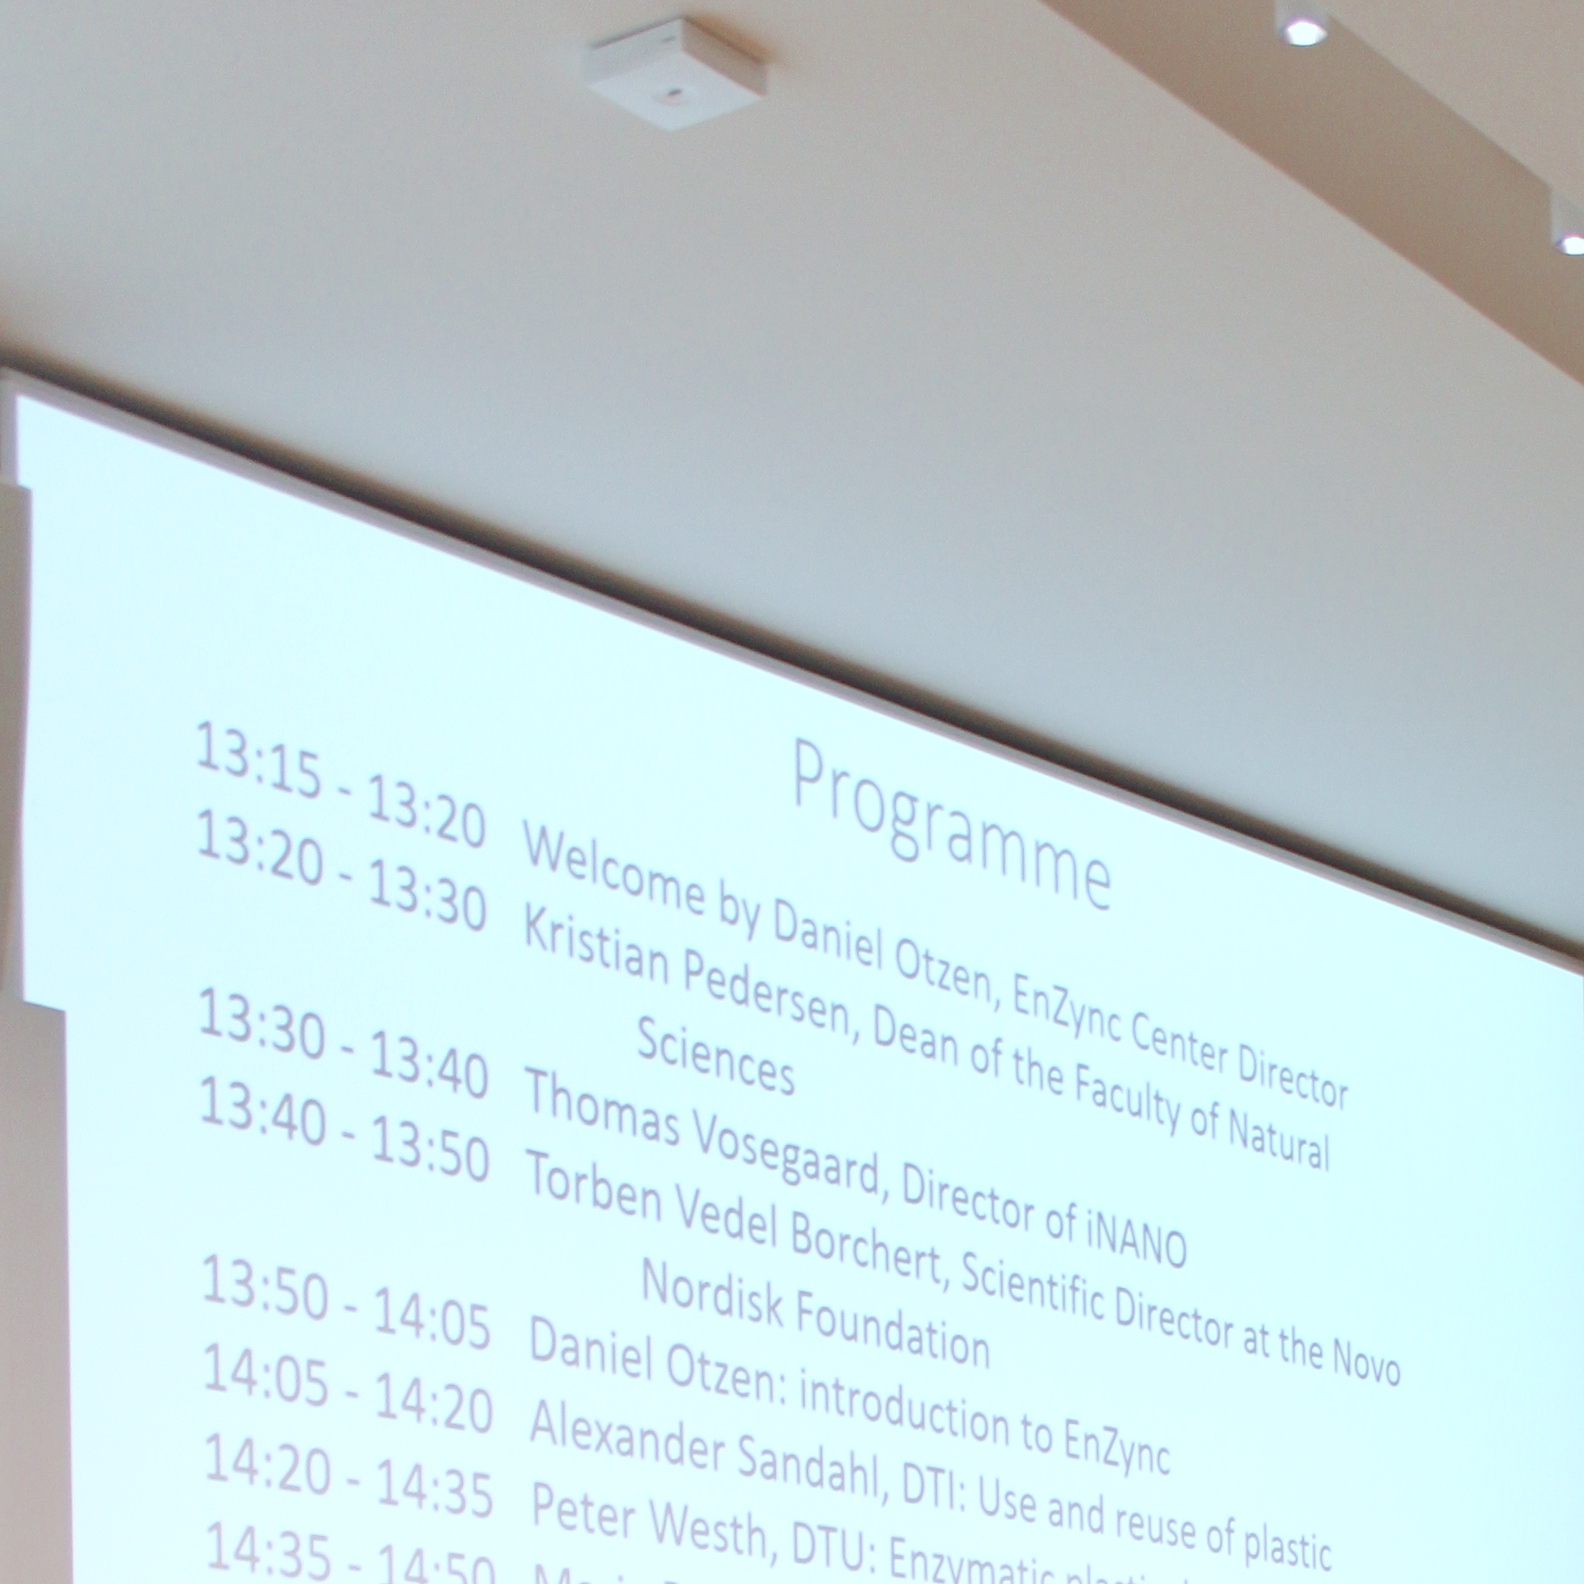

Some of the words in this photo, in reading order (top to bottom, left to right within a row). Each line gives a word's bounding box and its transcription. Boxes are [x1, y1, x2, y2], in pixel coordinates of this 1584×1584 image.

[197, 720, 322, 800] 13:15
[369, 774, 486, 849] 13:20
[523, 820, 705, 916] Welcome
[720, 879, 761, 942] by
[774, 898, 882, 969] Daniel
[895, 938, 1001, 1012] Otzen,
[1014, 973, 1121, 1042] EnZync
[1132, 1011, 1228, 1072] Center
[1239, 1043, 1349, 1109] Director
[795, 737, 1111, 911] Programme
[198, 808, 324, 886] 13:20
[370, 858, 487, 932] 13:30
[526, 902, 669, 984] Kristian
[685, 948, 860, 1045] Pedersen,
[874, 1003, 958, 1065] Dean
[970, 1037, 1003, 1077] of
[1012, 1047, 1064, 1096] the
[1076, 1063, 1181, 1137] Faculty
[1191, 1101, 1220, 1138] of
[1229, 1108, 1329, 1171] Natural
[638, 1015, 795, 1096] Sciences
[200, 986, 326, 1060] 13:30
[372, 1030, 489, 1100] 13:40
[524, 1066, 680, 1147] Thomas
[692, 1109, 889, 1204] Vosegaard,
[903, 1162, 1035, 1230] Director
[1046, 1202, 1077, 1241] of
[1087, 1211, 1187, 1269] iNANO
[201, 1075, 327, 1147] 13:40
[373, 1115, 490, 1183] 13:50
[525, 1148, 662, 1221] Torben
[675, 1184, 777, 1247] Vedel
[792, 1210, 950, 1293] Borchert,
[962, 1251, 1104, 1321] Scientific
[1116, 1286, 1234, 1347] Director
[1244, 1325, 1270, 1358] at
[1278, 1327, 1324, 1370] the
[1333, 1338, 1401, 1387] Novo
[203, 1254, 329, 1321] 13:50
[376, 1287, 491, 1351] 14:05
[531, 1315, 652, 1380] Daniel
[667, 1343, 786, 1405] Otzen:
[801, 1378, 1009, 1445] introduction
[1021, 1415, 1053, 1454] to
[1065, 1418, 1170, 1478] EnZync
[643, 1257, 783, 1327] Nordisk
[797, 1290, 990, 1368] Foundation
[205, 1342, 329, 1407] 14:05
[377, 1372, 494, 1434] 14:20
[530, 1399, 726, 1471] Alexander
[738, 1434, 889, 1506] Sandahl,
[903, 1462, 965, 1511] DTI:
[979, 1475, 1037, 1523] Use
[1048, 1494, 1104, 1534] and
[1116, 1510, 1196, 1550] reuse
[1207, 1516, 1235, 1554] of
[1245, 1523, 1332, 1572] plastic
[206, 1432, 331, 1496] 14:20
[378, 1458, 493, 1519] 14:35
[533, 1481, 636, 1538] Peter
[649, 1500, 778, 1567] Westh,
[793, 1521, 875, 1573] DTU:
[208, 1521, 332, 1582] 14:35
